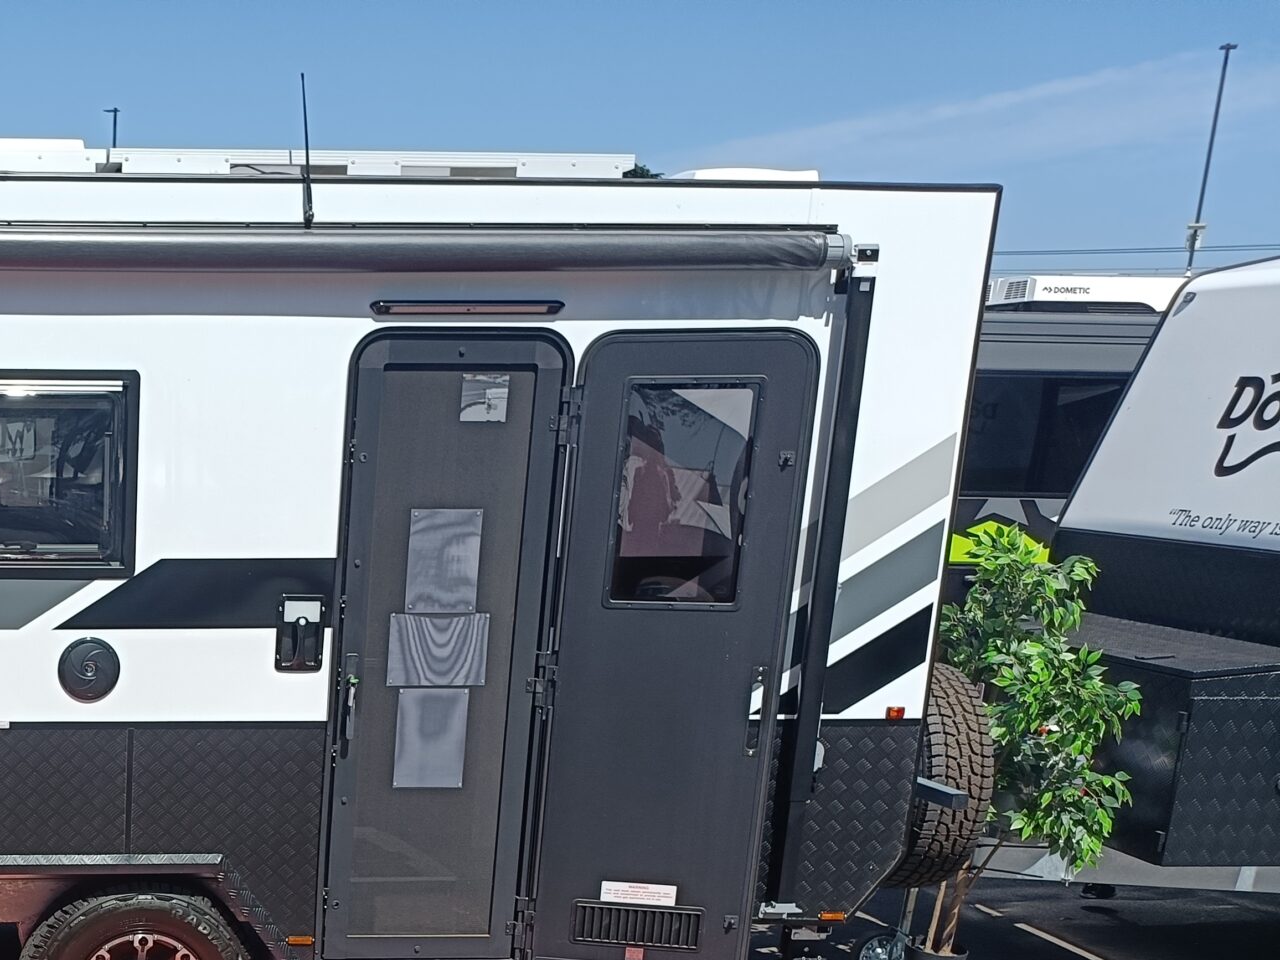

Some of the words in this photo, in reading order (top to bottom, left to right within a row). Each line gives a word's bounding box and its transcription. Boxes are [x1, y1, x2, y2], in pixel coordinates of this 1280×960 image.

[1053, 286, 1091, 295] DOMETIC
[1201, 512, 1237, 536] only
[1236, 518, 1272, 540] way
